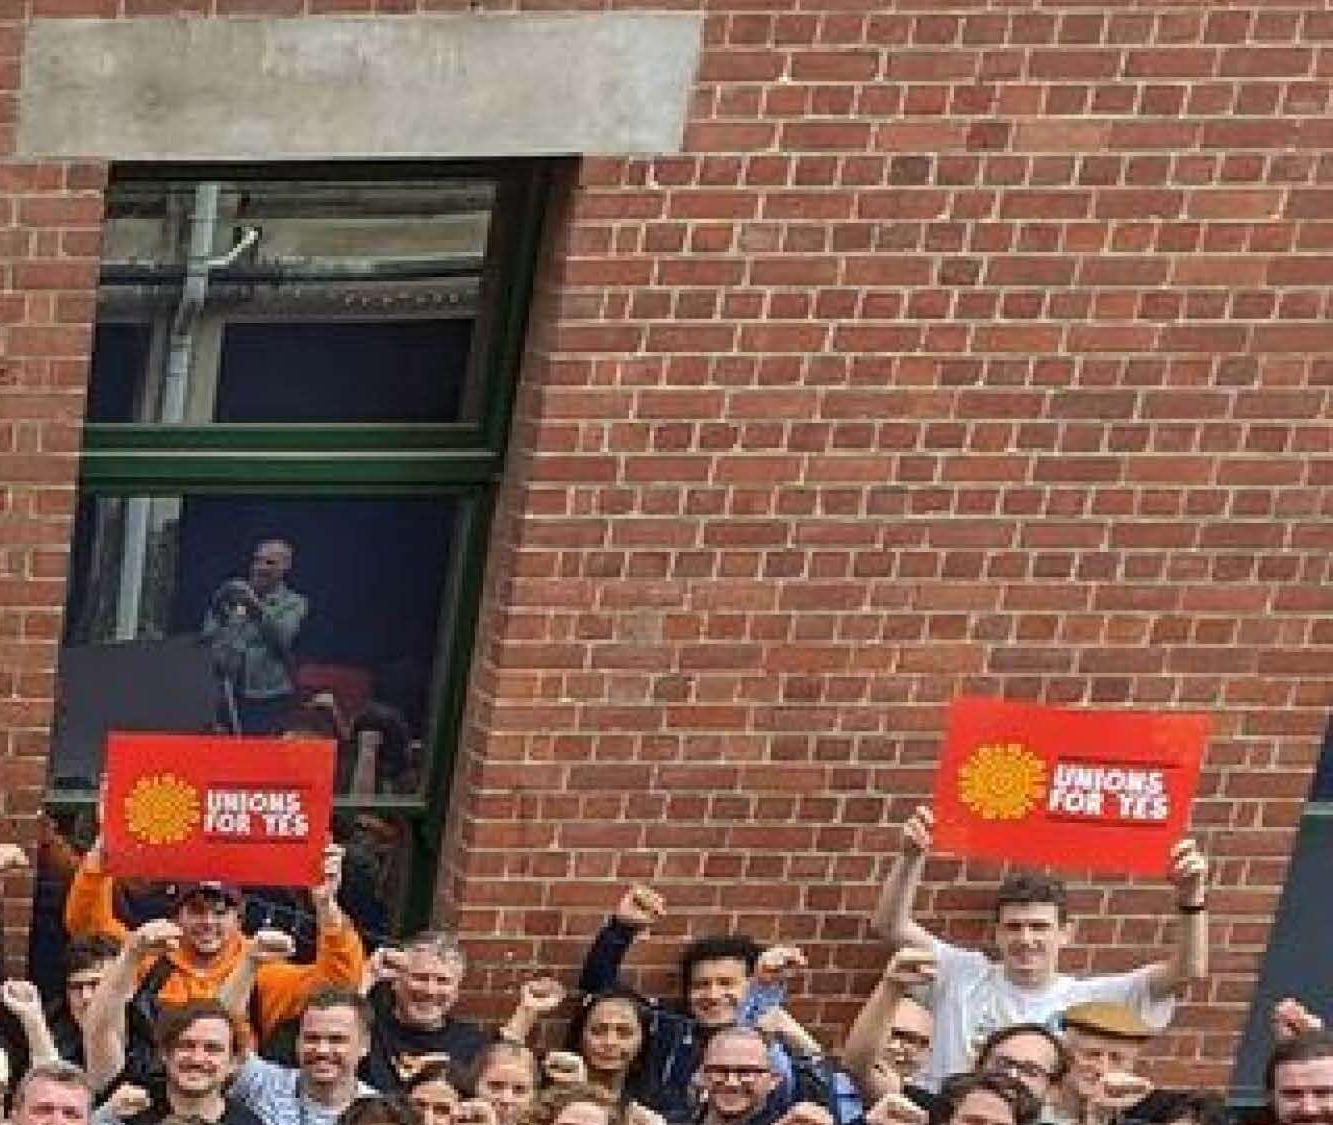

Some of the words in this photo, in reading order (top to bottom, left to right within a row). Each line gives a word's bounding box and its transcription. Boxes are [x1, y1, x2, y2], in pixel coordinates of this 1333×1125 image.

[1052, 763, 1165, 795] UNIONS
[206, 788, 302, 813] UNIONS
[1048, 788, 1105, 815] FOR
[1117, 793, 1170, 820] YES
[203, 812, 251, 834] FOR
[262, 813, 309, 837] YES
